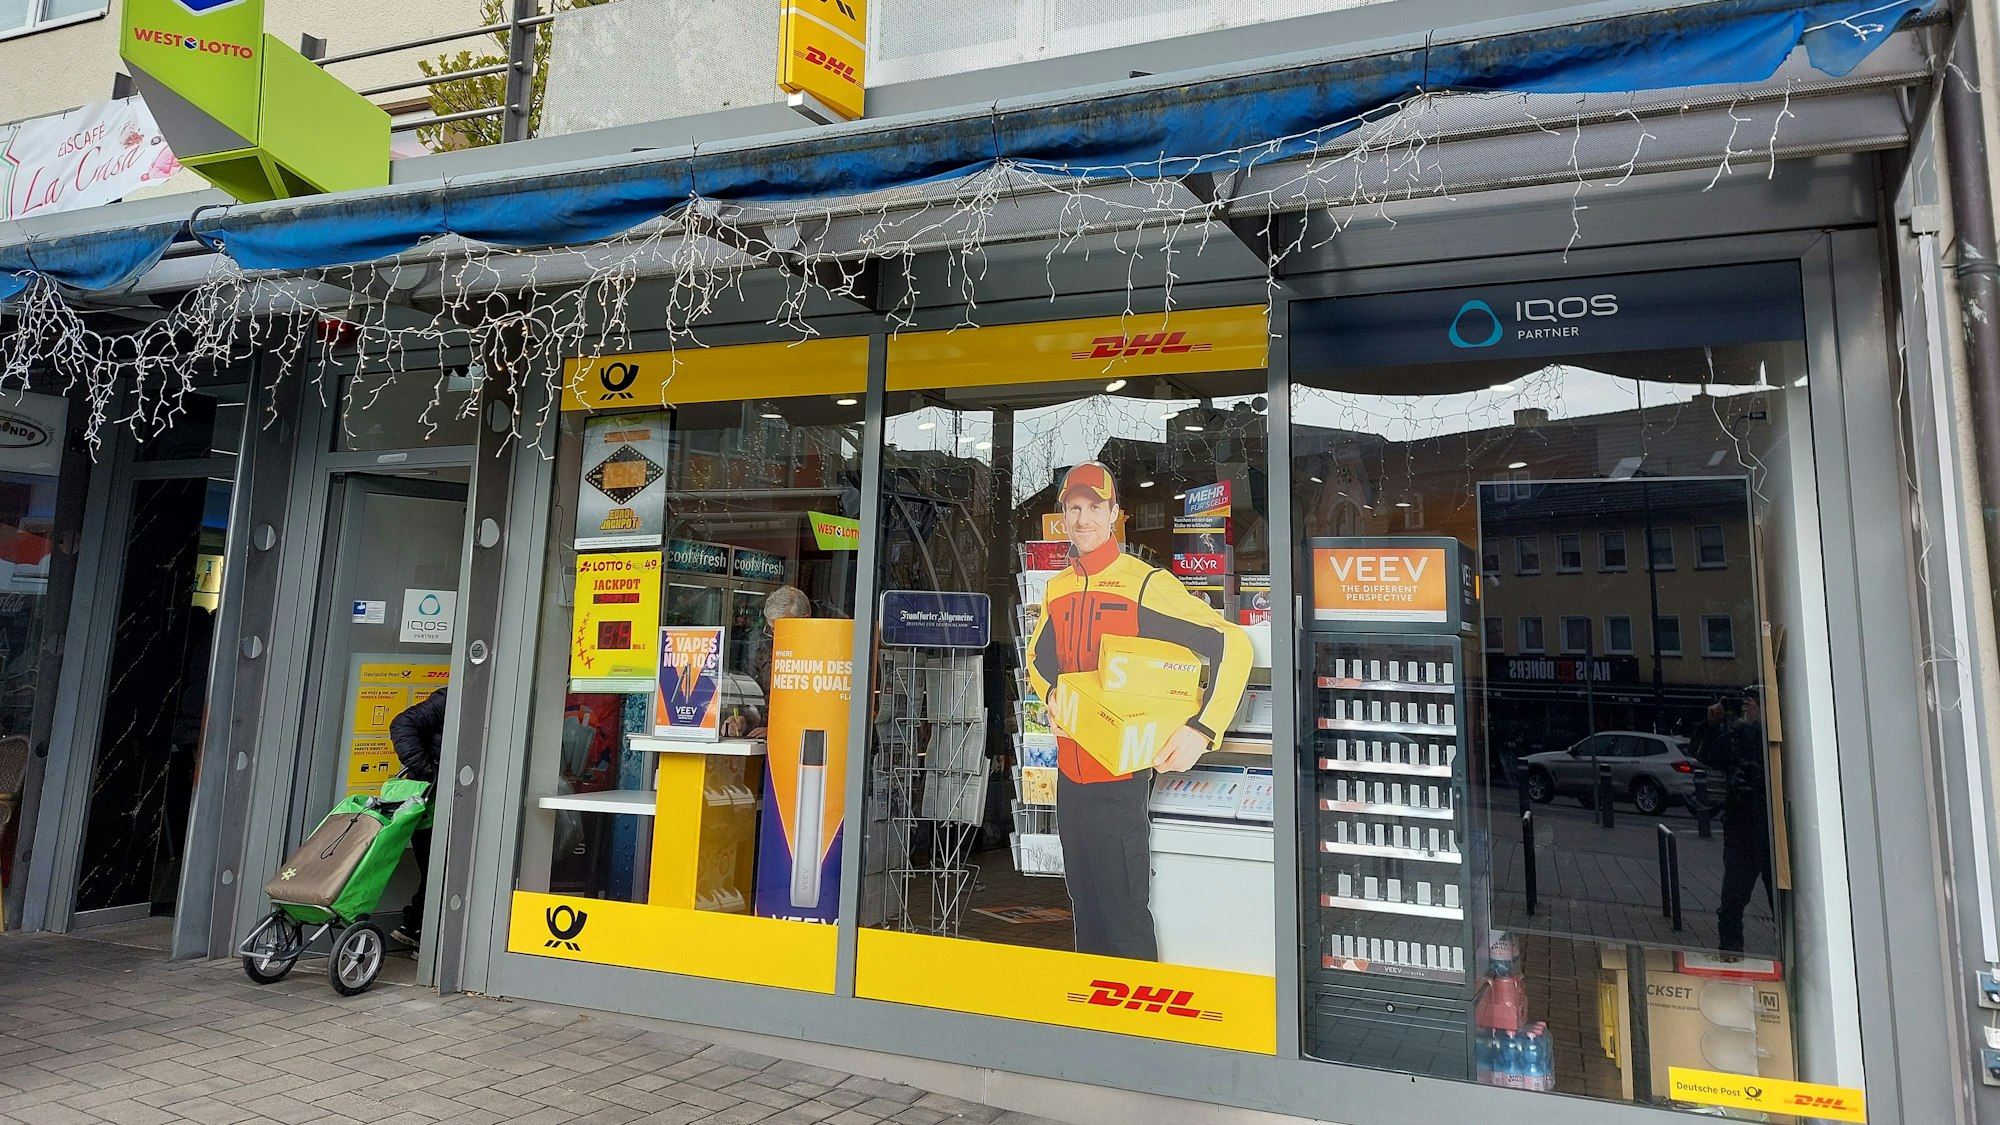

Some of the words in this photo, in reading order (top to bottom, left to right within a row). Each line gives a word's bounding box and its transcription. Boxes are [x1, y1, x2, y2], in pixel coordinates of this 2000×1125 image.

[133, 27, 183, 47] WEST
[199, 39, 253, 59] LOTTO
[805, 46, 857, 84] DHL
[58, 121, 105, 158] EISCAFÉ
[21, 166, 65, 215] La
[75, 145, 145, 192] Casa
[1515, 294, 1619, 323] IQOS
[1518, 326, 1580, 340] PARTNER
[1091, 331, 1193, 359] DHL
[0, 421, 36, 441] ONDO
[1188, 485, 1225, 504] MEHR
[1210, 496, 1229, 507] GELD!
[608, 508, 635, 519] EURO
[600, 517, 641, 530] JACKPOT
[817, 523, 836, 535] WEST
[593, 561, 623, 572] LOTTO
[1180, 555, 1218, 571] ELIXYR
[1329, 556, 1428, 582] VEEV
[593, 578, 641, 591] JACKPOT
[1341, 584, 1361, 593] THE
[1363, 585, 1419, 594] DIFFERENT
[1346, 593, 1414, 602] PERSPECTIVE
[938, 610, 974, 623] Allgemeine
[407, 620, 448, 632] IQOS
[664, 637, 673, 652] 2
[676, 637, 717, 653] VAPES
[663, 652, 689, 668] NUR
[774, 659, 824, 674] PREMIUM
[827, 660, 853, 675] DES
[1163, 662, 1197, 673] PACKSET
[1107, 656, 1129, 689] S
[773, 673, 810, 691] MEETS
[812, 675, 851, 693] QUAL
[675, 706, 698, 714] VEEV
[1056, 683, 1079, 735] M
[1100, 711, 1116, 726] DHL
[1120, 721, 1157, 771] M
[801, 868, 809, 891] VEEV
[1384, 966, 1403, 974] VEEV
[1087, 979, 1202, 1018] DHL
[1647, 984, 1693, 999] CKSET
[1676, 1081, 1719, 1095] Deutsche
[1720, 1087, 1741, 1097] Post
[1794, 1094, 1848, 1110] DHL
